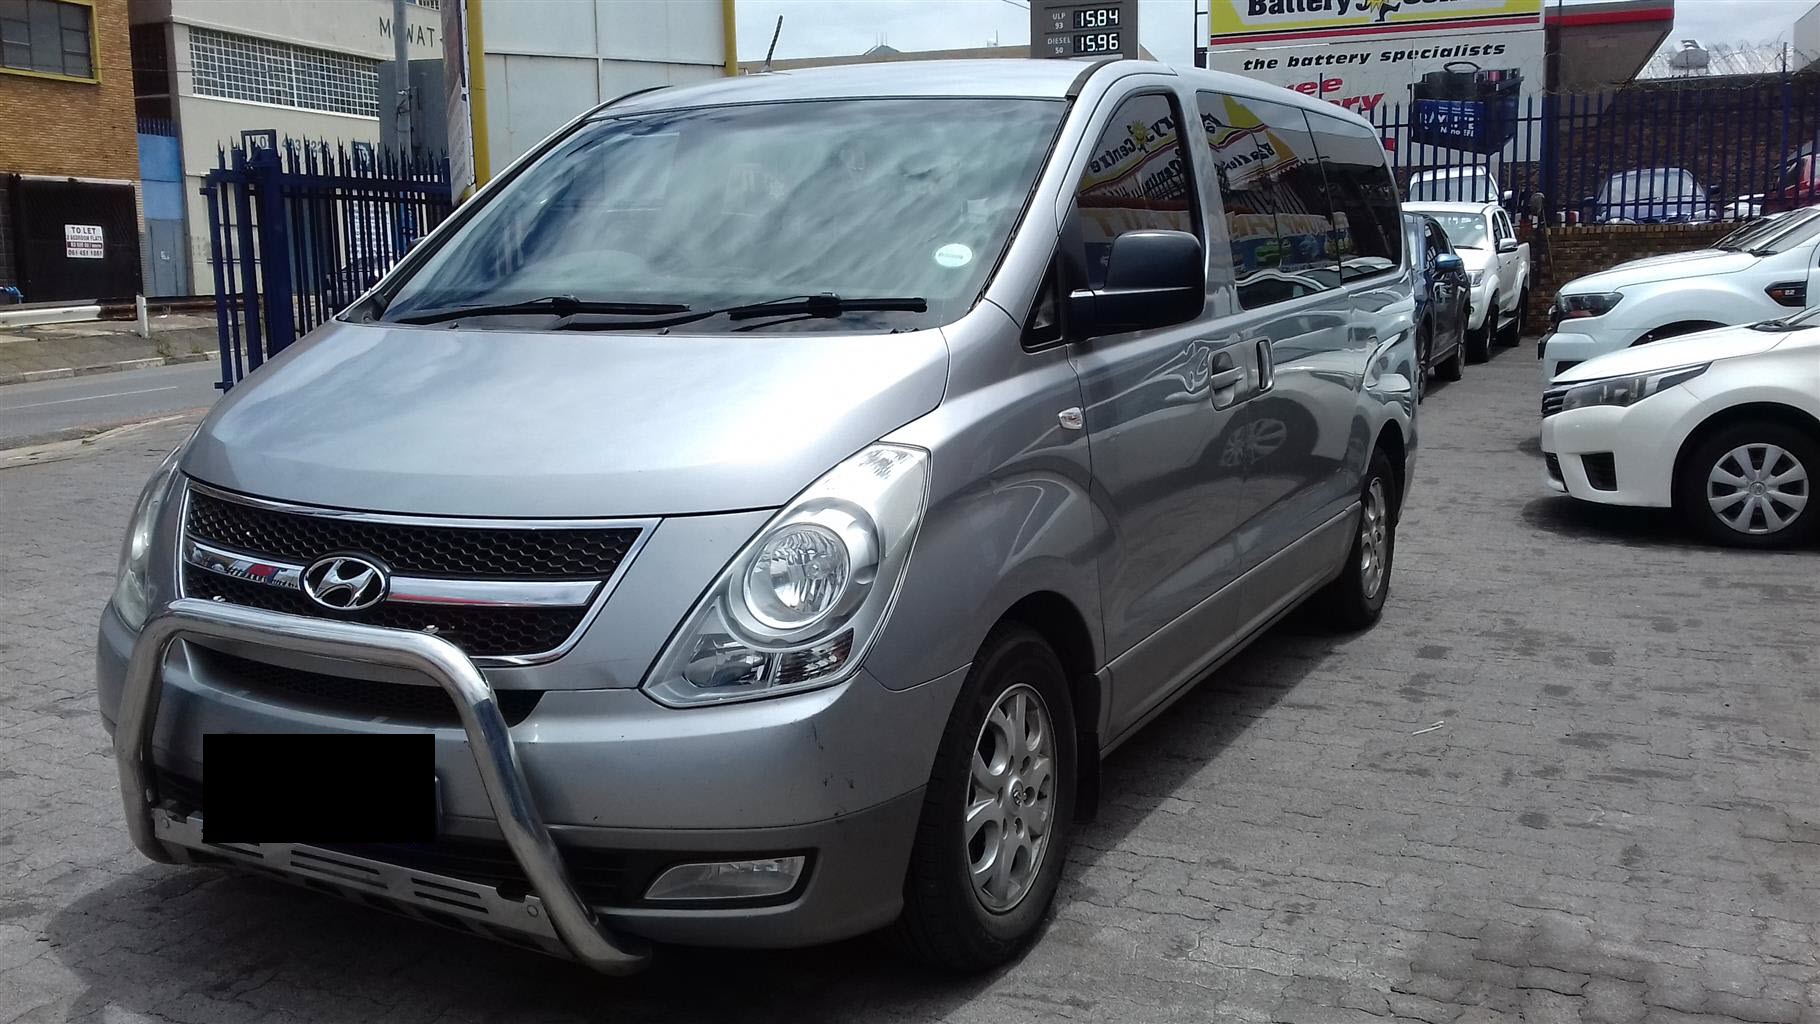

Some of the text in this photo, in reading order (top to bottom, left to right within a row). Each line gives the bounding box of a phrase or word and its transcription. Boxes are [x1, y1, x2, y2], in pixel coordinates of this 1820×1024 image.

[1052, 9, 1119, 27] ULP 15.84
[1055, 22, 1064, 30] 93
[1047, 33, 1119, 52] DIESEL 15.96
[1055, 46, 1064, 54] 50
[1243, 43, 1506, 71] the battery specialists
[83, 227, 96, 235] LET
